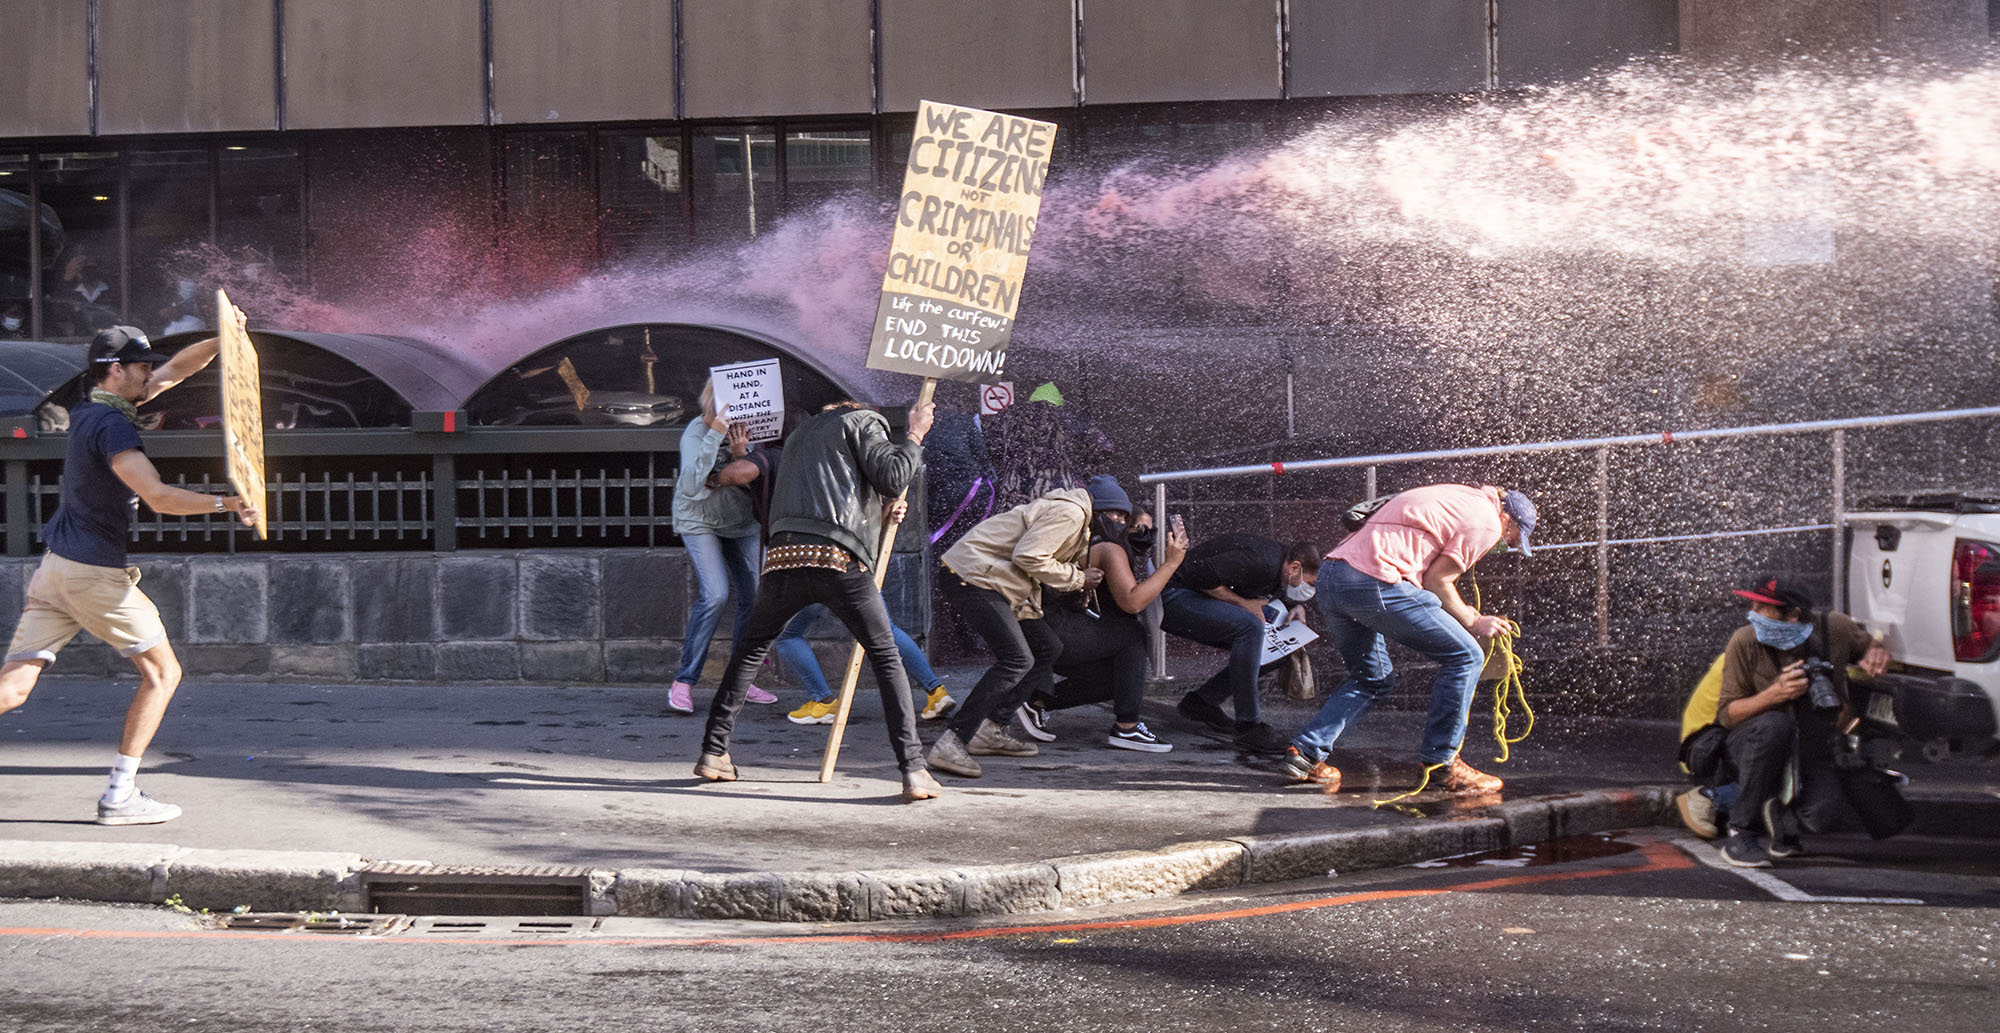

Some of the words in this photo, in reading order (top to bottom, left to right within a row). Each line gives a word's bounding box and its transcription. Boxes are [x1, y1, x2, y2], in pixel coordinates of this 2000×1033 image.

[926, 105, 973, 139] WE
[980, 114, 1046, 158] ARE
[910, 136, 1049, 195] CITIZENS
[961, 188, 991, 202] NOT
[899, 190, 1036, 256] CRIMINALS
[947, 240, 973, 263] OR
[888, 252, 1018, 313] CHILDREN
[919, 299, 944, 315] the
[947, 308, 1008, 332] curfew!
[885, 315, 928, 337] END
[941, 323, 982, 345] THIS
[883, 337, 1007, 375] LOCKDOWN!
[726, 370, 754, 380] HAND
[756, 368, 767, 376] IN
[733, 380, 763, 390] HAND,
[729, 400, 772, 412] DISTANCE
[740, 392, 750, 400] AT
[731, 413, 754, 421] WITH
